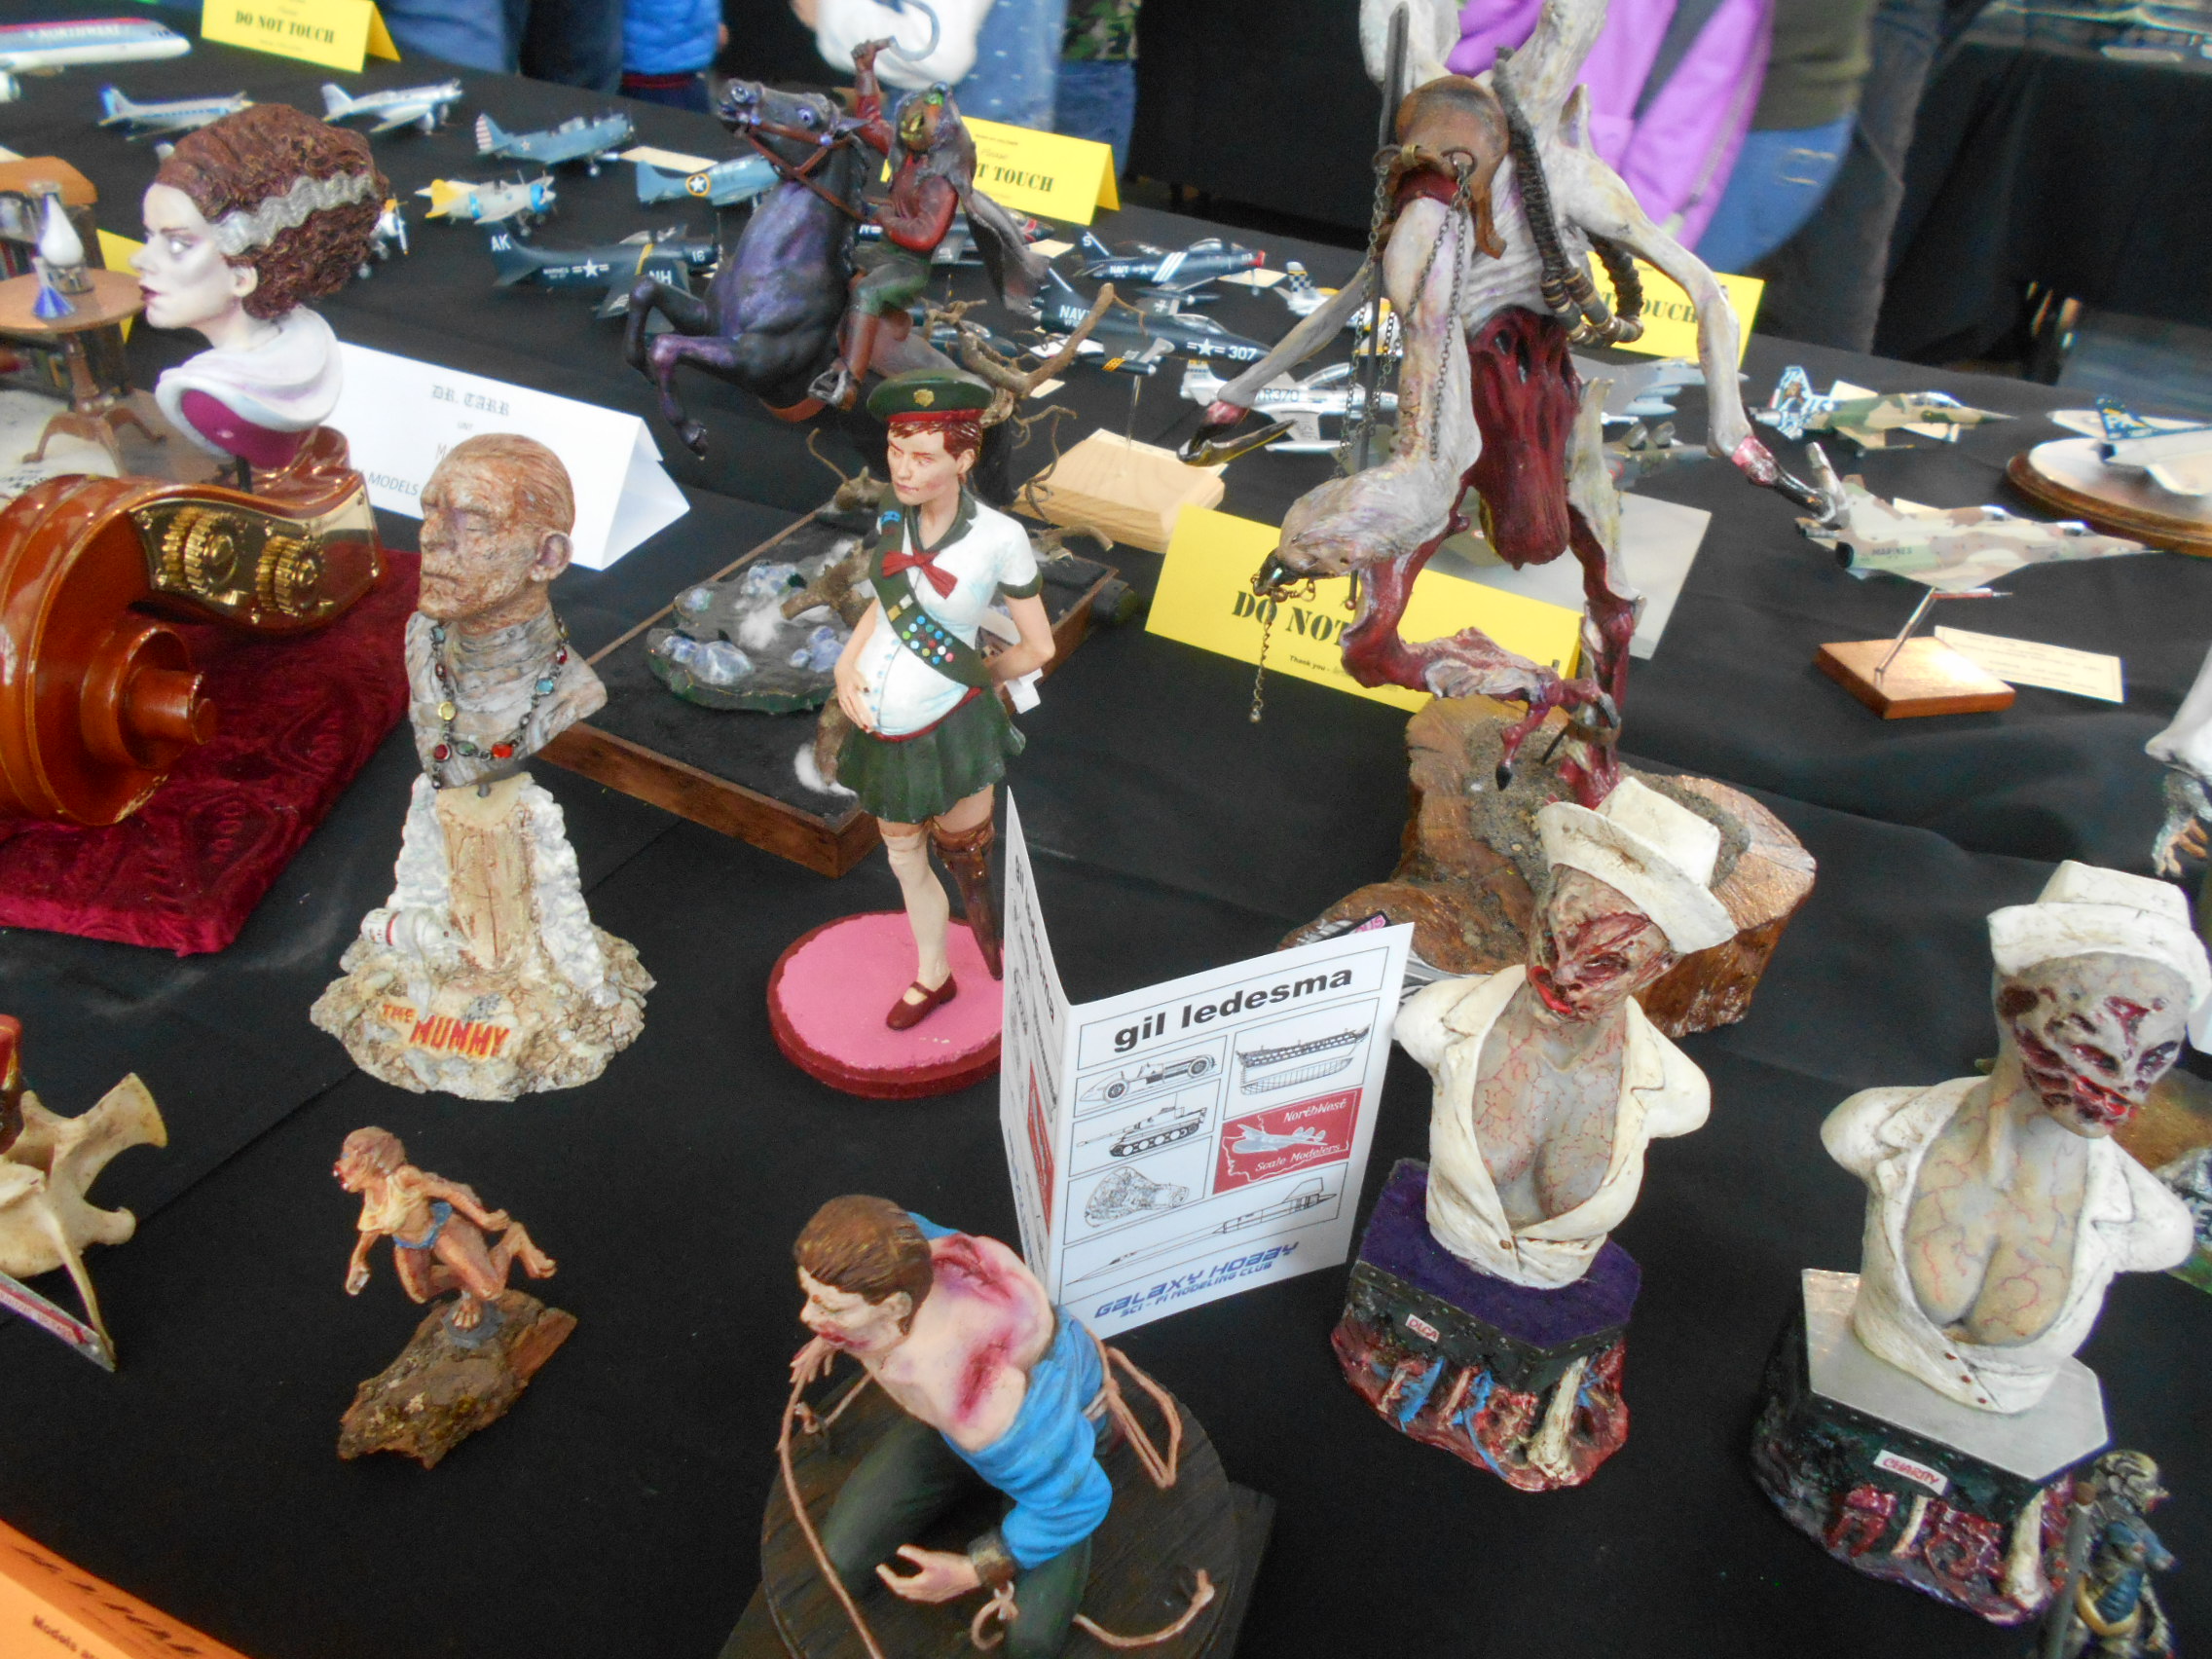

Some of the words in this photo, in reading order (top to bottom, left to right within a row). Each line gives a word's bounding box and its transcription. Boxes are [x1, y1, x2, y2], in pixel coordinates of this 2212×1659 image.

[236, 10, 253, 25] DO
[258, 15, 283, 33] NOT
[289, 21, 334, 44] TOUCH
[994, 166, 1054, 192] TOUCH
[492, 234, 512, 251] AK
[692, 250, 705, 262] 16
[1110, 265, 1129, 274] NAVY
[1059, 305, 1091, 321] NAV
[1640, 297, 1698, 323] OUCH
[1228, 346, 1257, 361] 307
[369, 472, 419, 496] MODELS
[1232, 590, 1277, 624] DO
[1289, 655, 1310, 667] Thank
[1312, 662, 1326, 672] you
[383, 1004, 415, 1023] THE
[1114, 1012, 1165, 1052] gil
[1181, 969, 1352, 1029] ledesma
[410, 1015, 510, 1059] MUMMY
[1255, 1158, 1286, 1172] Scale
[1291, 1144, 1342, 1163] Modelers
[1120, 1304, 1142, 1317] SCI
[1170, 1273, 1235, 1300] MODELING
[1239, 1261, 1272, 1277] CLUB
